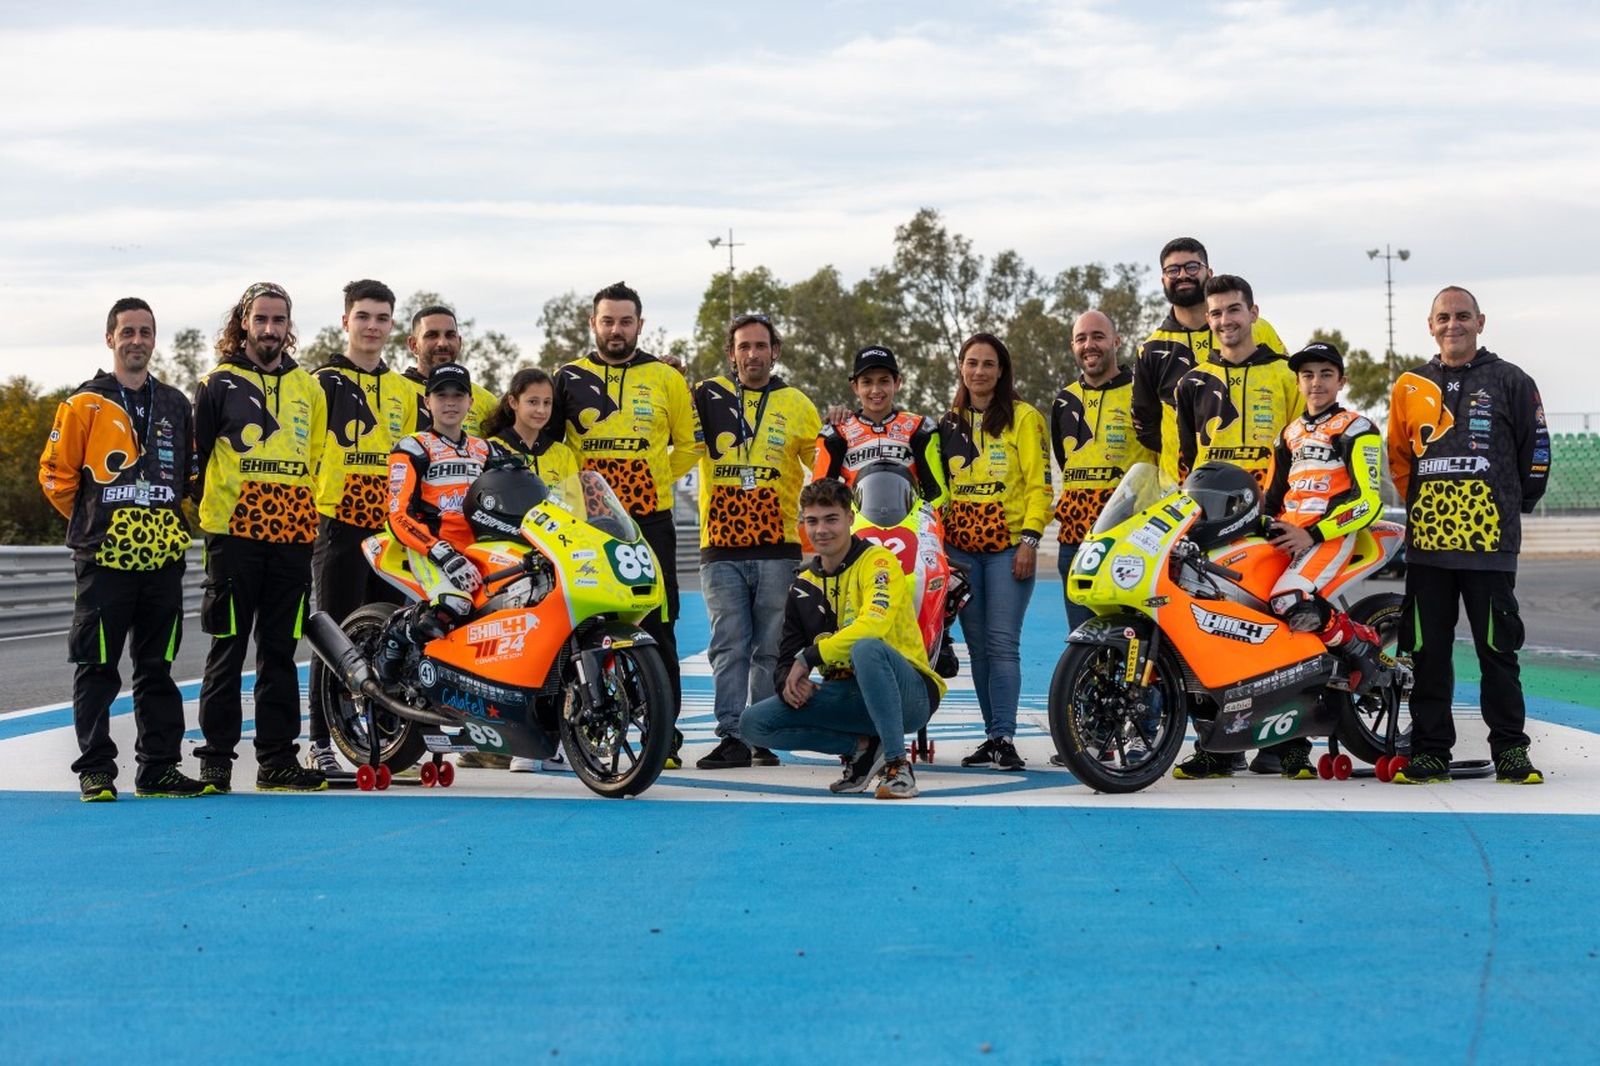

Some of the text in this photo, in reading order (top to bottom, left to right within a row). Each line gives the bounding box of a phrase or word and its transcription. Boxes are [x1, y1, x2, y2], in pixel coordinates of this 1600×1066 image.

[471, 509, 521, 535] SCORPION
[614, 544, 655, 579] 89
[497, 635, 525, 655] 24
[422, 665, 434, 681] 41
[465, 721, 503, 748] 89
[1258, 709, 1298, 740] 76
